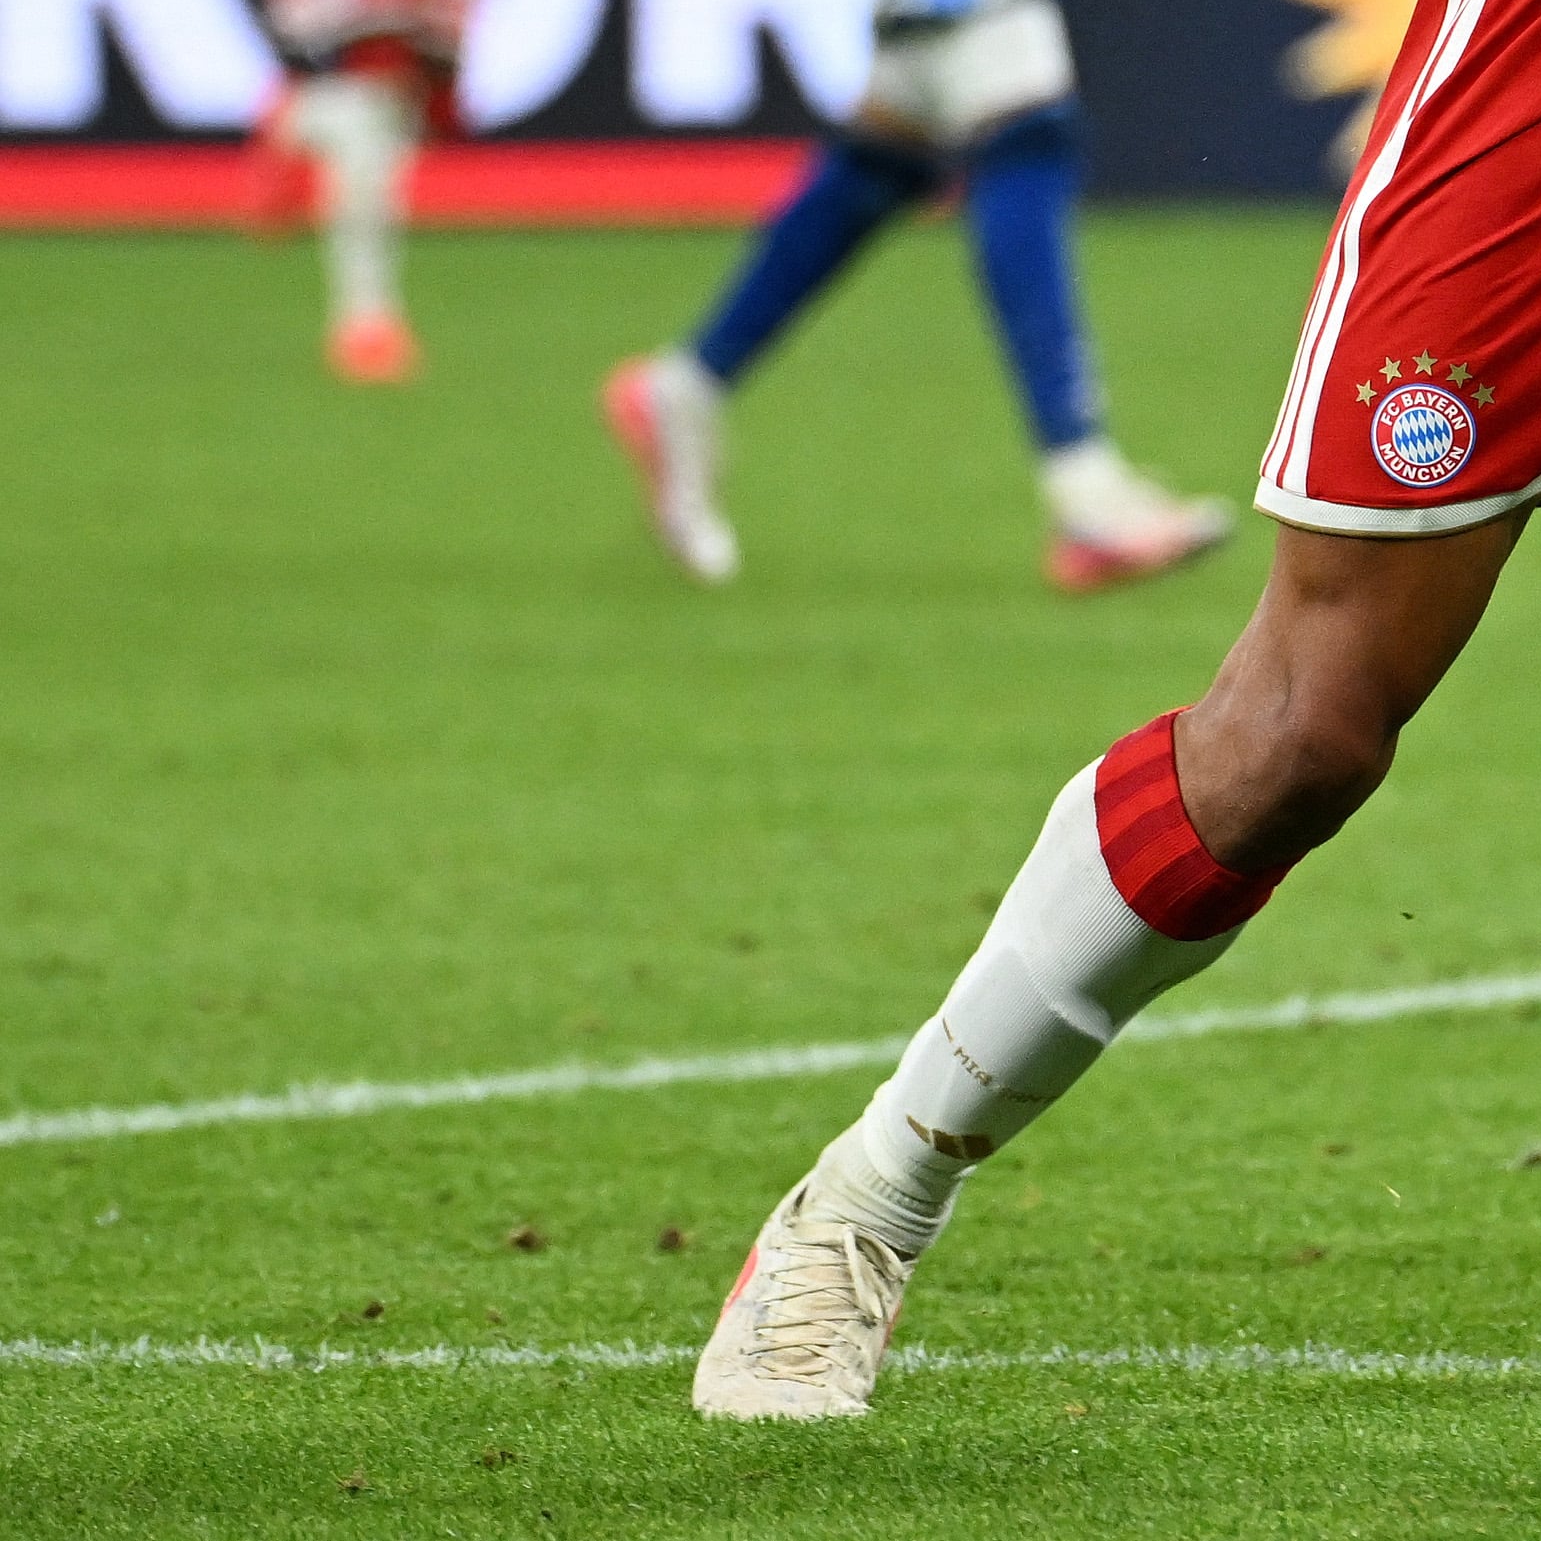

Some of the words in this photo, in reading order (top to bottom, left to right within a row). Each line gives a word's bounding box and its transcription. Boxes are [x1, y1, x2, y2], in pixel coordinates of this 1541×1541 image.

[1381, 401, 1401, 427] FC
[1401, 391, 1467, 430] BAYERN
[1379, 442, 1465, 481] MÜNCHEN
